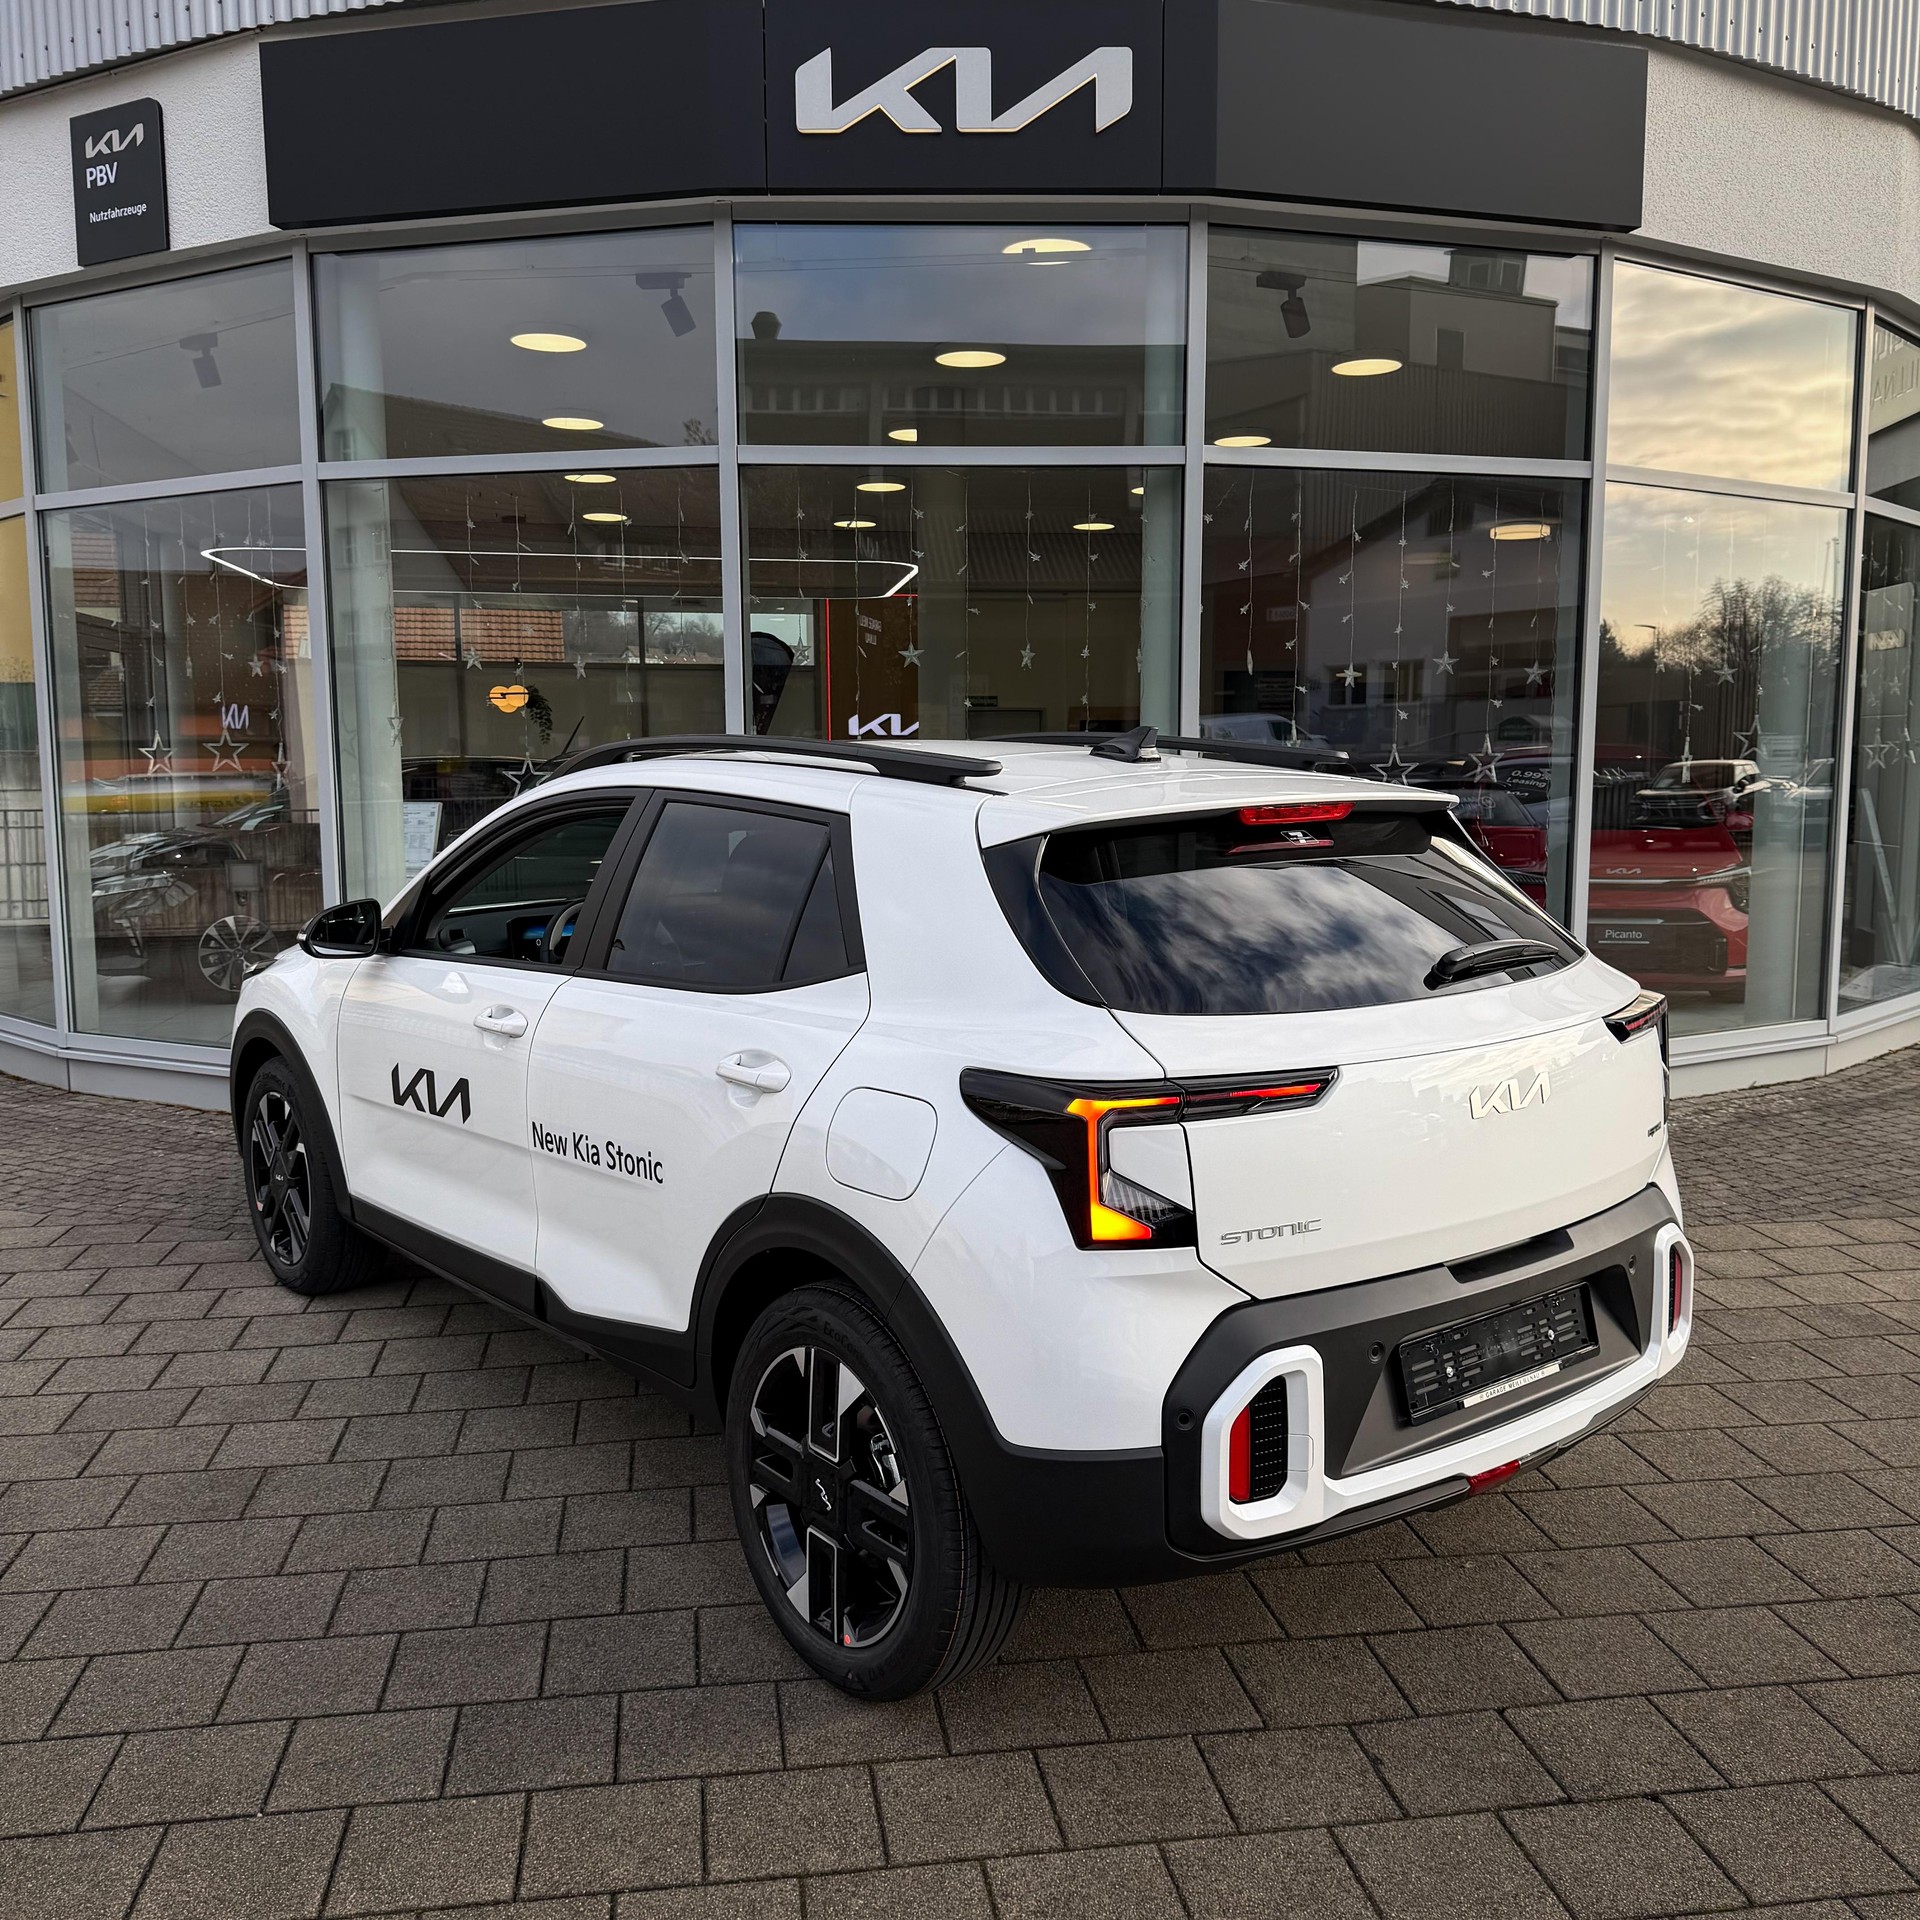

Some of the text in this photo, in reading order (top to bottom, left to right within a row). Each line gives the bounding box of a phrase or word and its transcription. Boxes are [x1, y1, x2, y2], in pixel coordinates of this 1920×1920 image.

[795, 46, 1132, 134] KIA
[85, 122, 145, 159] KIA
[86, 161, 118, 189] PBV
[89, 203, 147, 223] Nutzfahrzeuge
[222, 704, 249, 730] KIA
[1506, 777, 1547, 788] Leasing
[1605, 867, 1642, 875] KIA
[1605, 929, 1643, 940] Picanto
[391, 1062, 471, 1125] KIA
[1469, 1071, 1551, 1120] KIA
[532, 1121, 664, 1184] New Kia Stonic
[1220, 1218, 1322, 1245] STONIC
[1485, 1385, 1507, 1398] GARAGE
